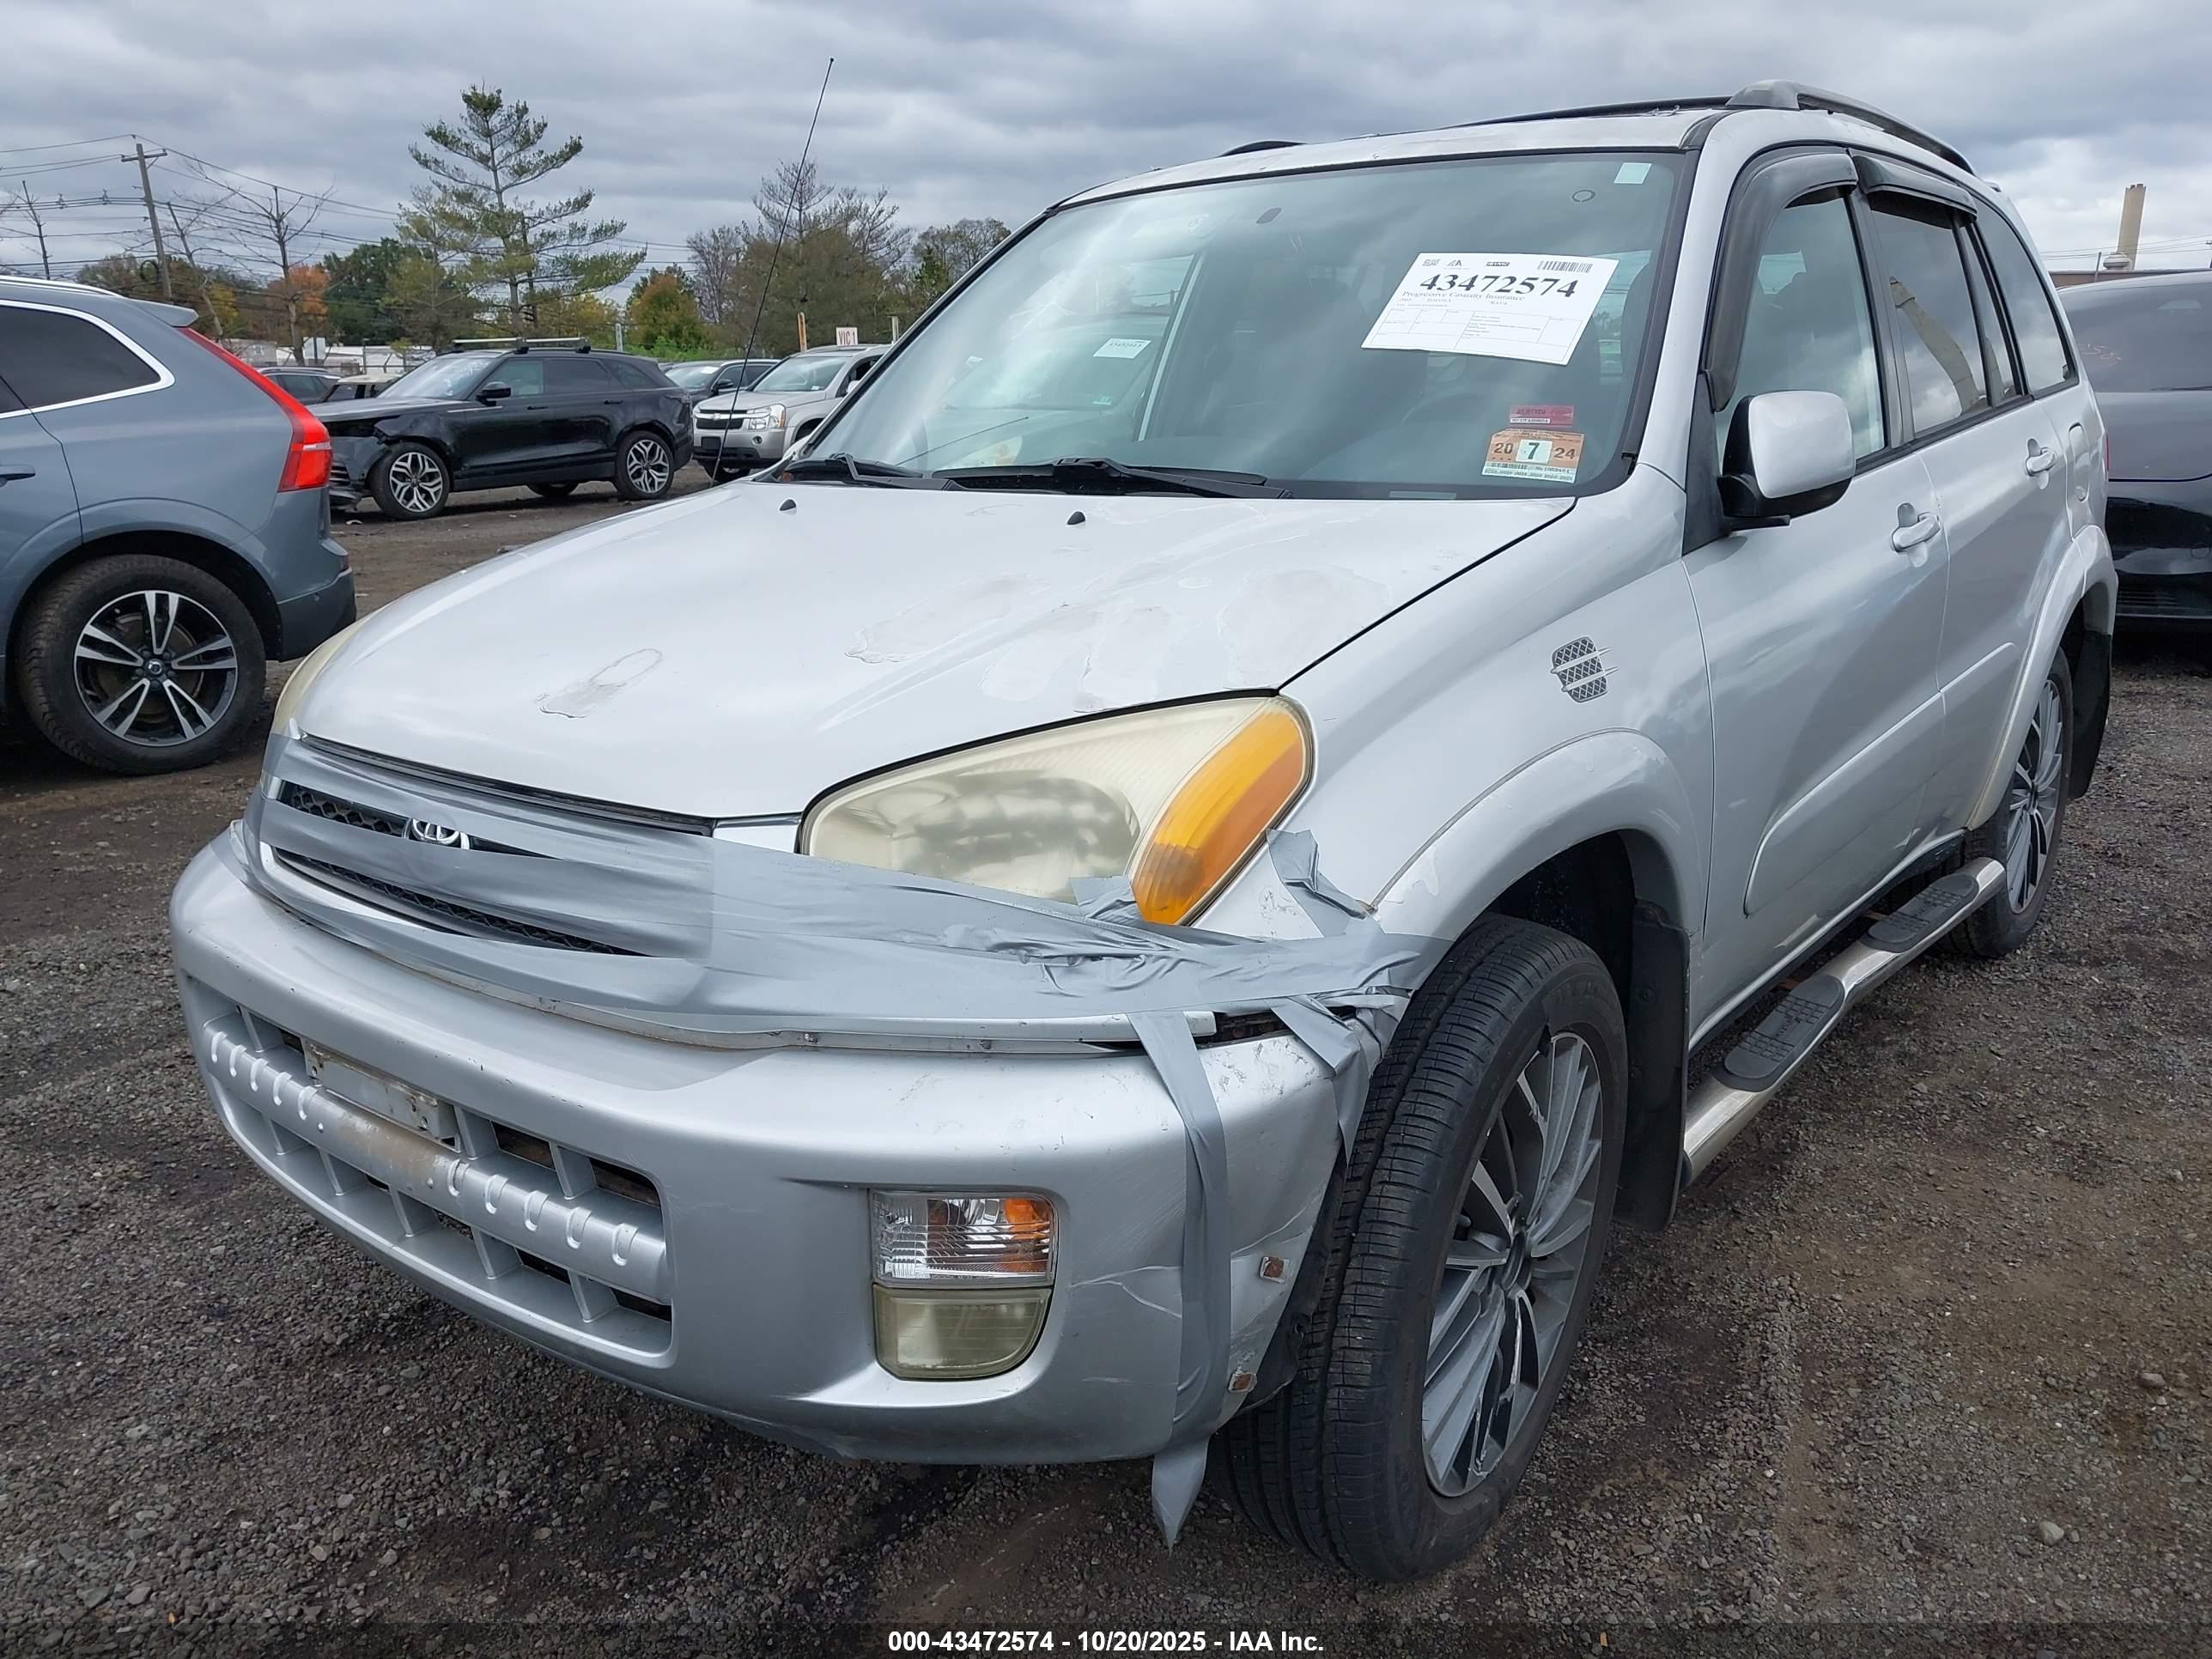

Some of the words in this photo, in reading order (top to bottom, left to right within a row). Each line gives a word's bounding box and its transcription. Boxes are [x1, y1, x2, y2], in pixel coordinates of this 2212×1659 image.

[1419, 273, 1579, 298] 43472574
[1401, 290, 1448, 300] Progressive
[1485, 293, 1526, 301] Insurance
[1494, 442, 1514, 454] 20
[1527, 441, 1540, 460] 7
[1553, 447, 1577, 459] 24
